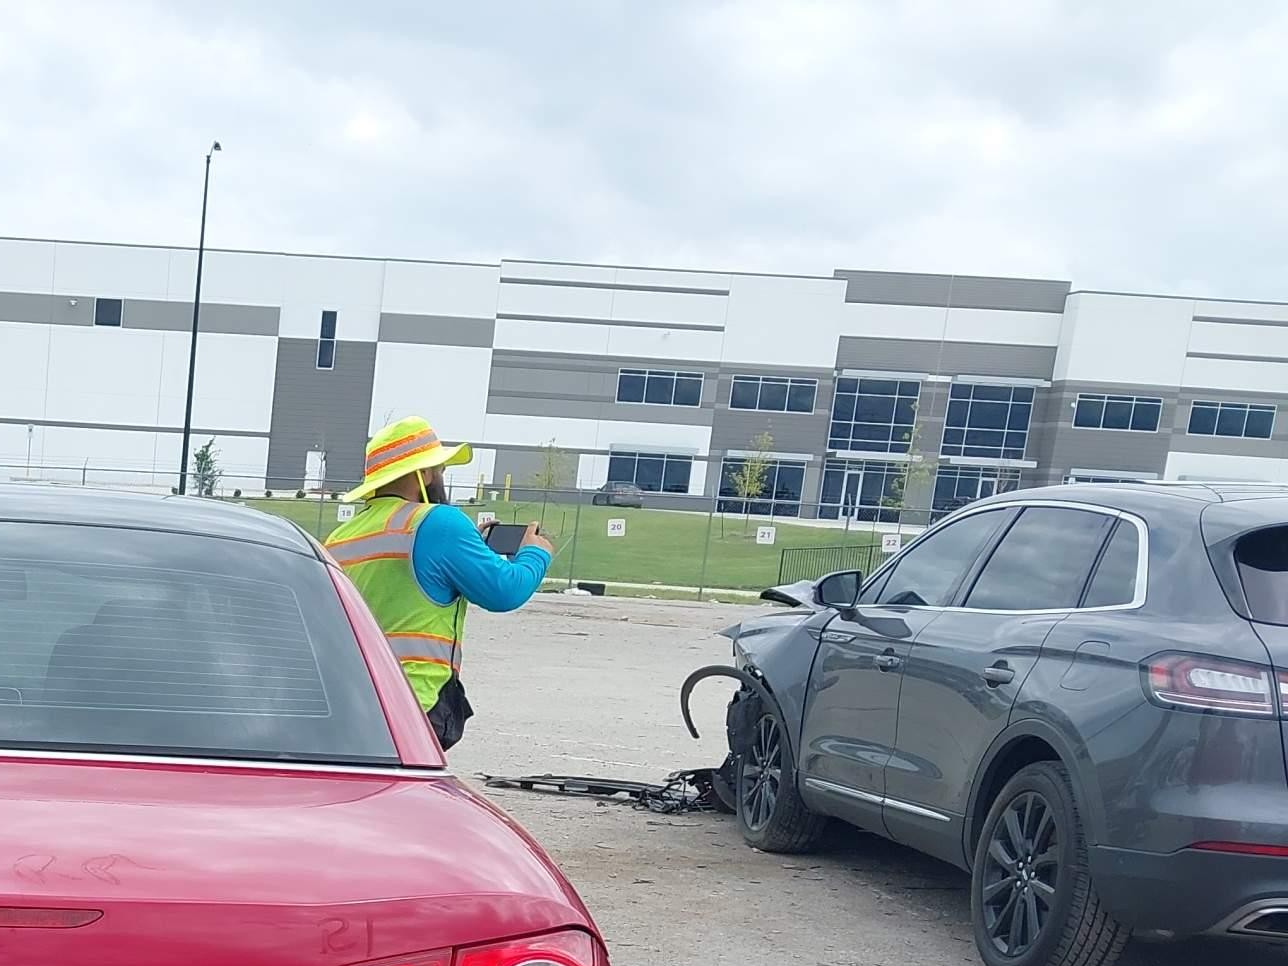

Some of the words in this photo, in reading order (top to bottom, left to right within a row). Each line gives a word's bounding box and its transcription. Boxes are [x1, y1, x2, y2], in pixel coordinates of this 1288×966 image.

[610, 523, 623, 531] 20
[759, 531, 772, 539] 21
[885, 539, 898, 547] 22
